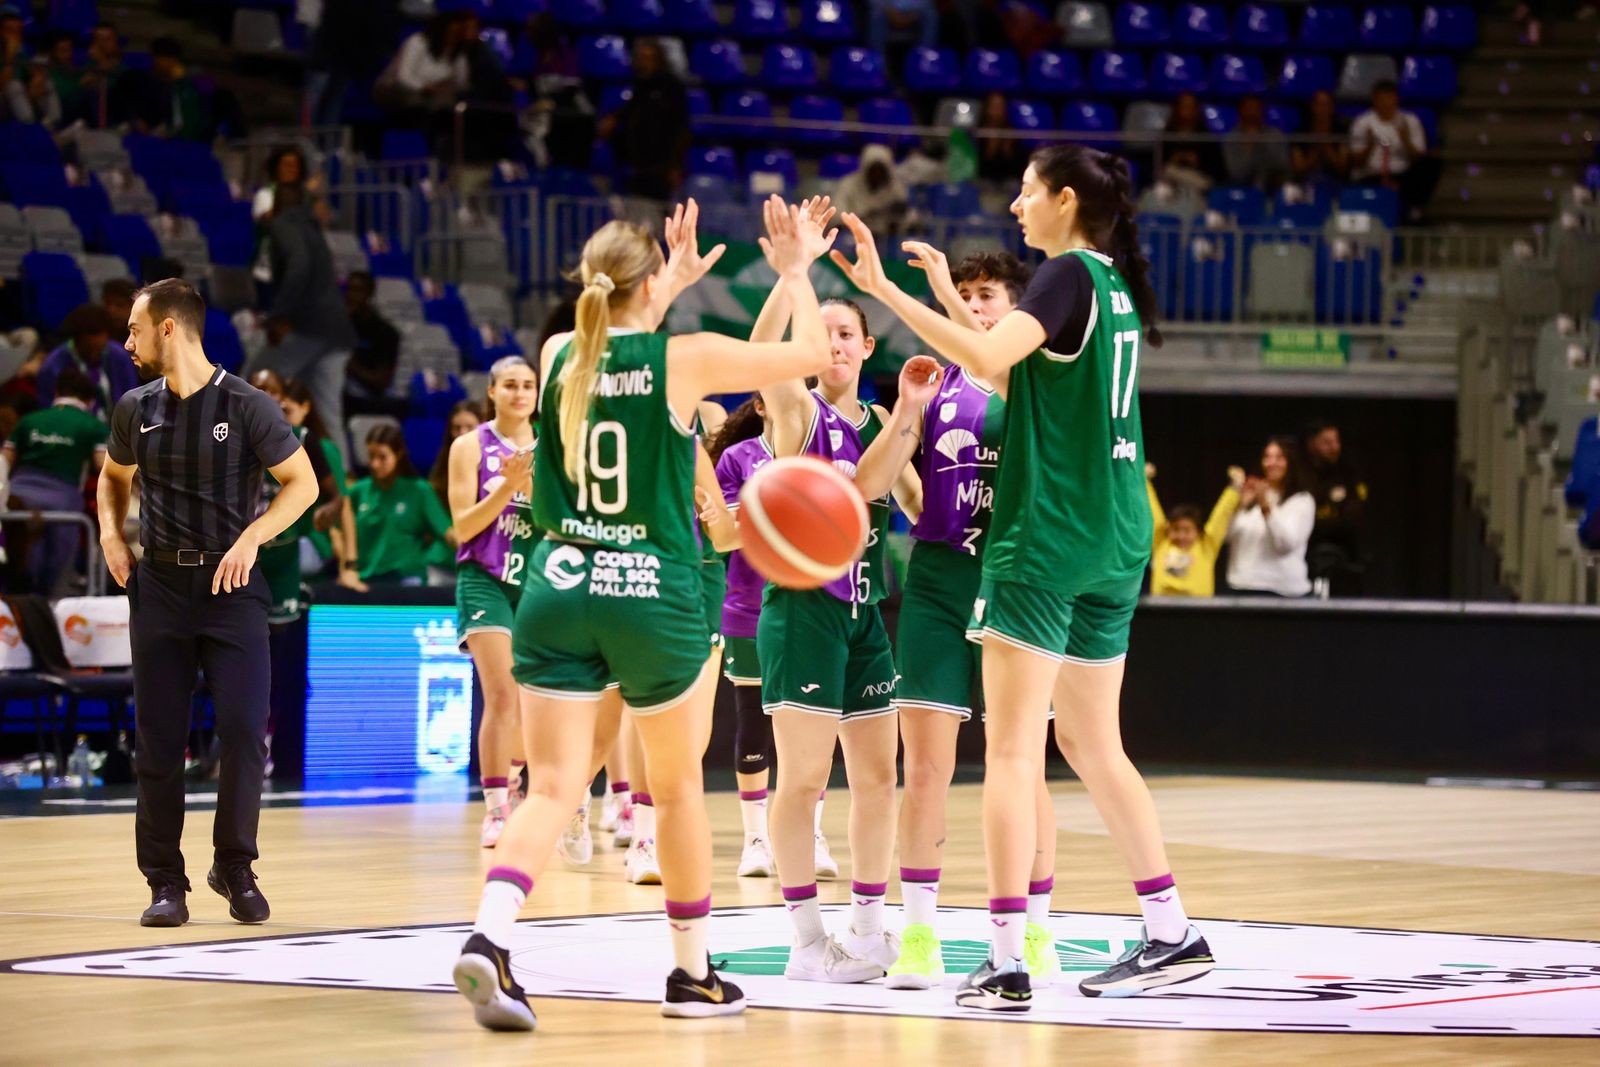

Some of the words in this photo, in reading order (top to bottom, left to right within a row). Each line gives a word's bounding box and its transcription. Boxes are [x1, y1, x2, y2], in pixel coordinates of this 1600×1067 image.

[1111, 330, 1139, 418] 17
[577, 420, 628, 515] 19
[956, 479, 994, 517] Mija
[496, 514, 532, 540] Mijas
[501, 552, 525, 586] 12
[591, 567, 624, 583] DEL
[625, 568, 660, 584] SOL
[593, 550, 661, 569] COSTA
[849, 561, 870, 604] 15
